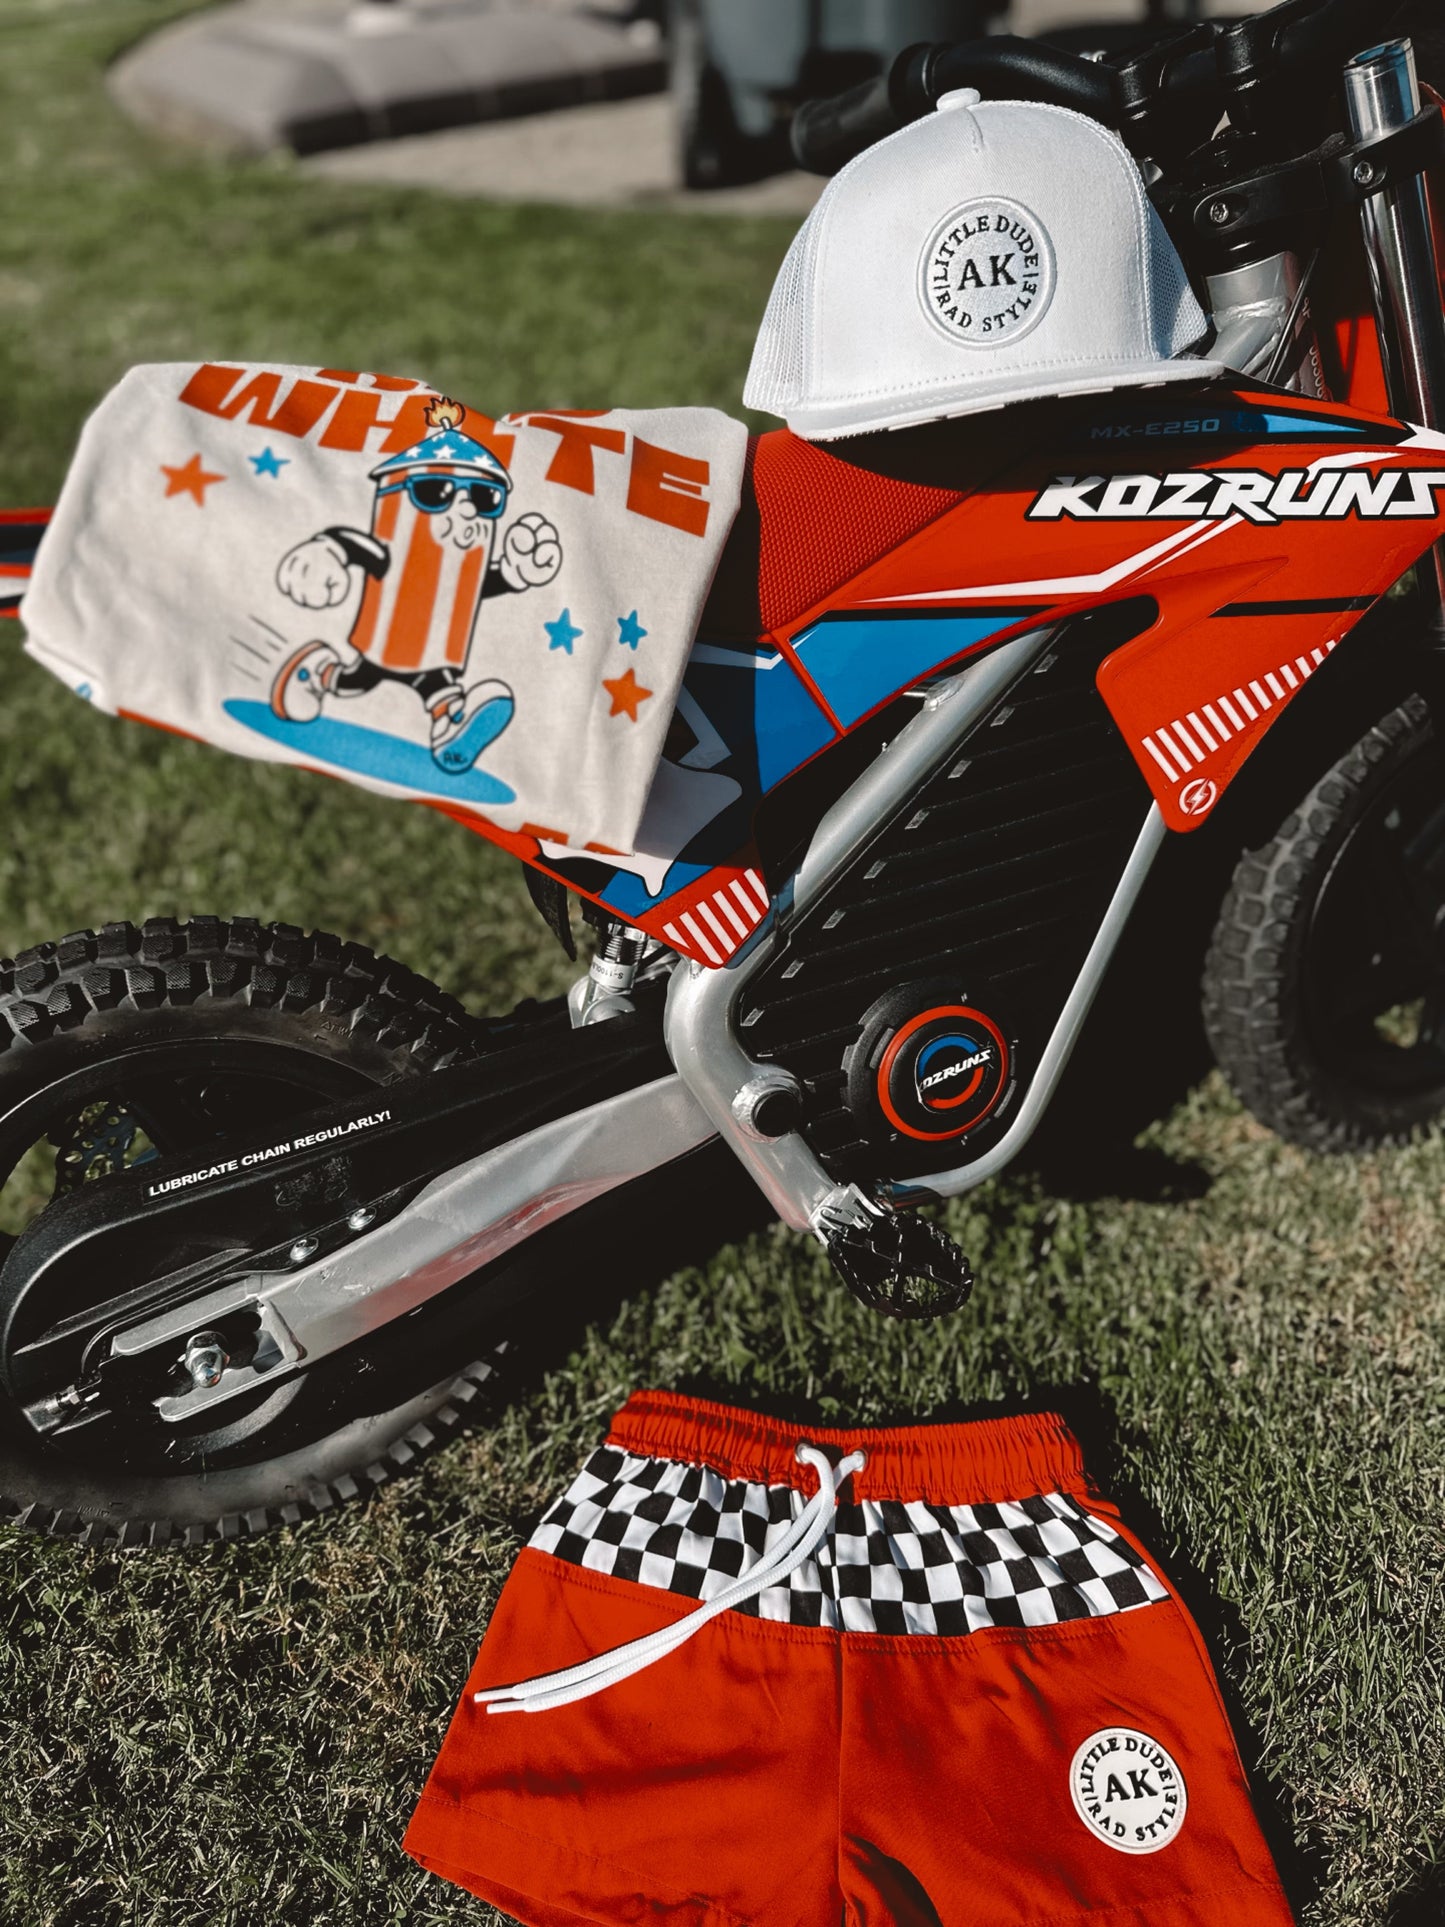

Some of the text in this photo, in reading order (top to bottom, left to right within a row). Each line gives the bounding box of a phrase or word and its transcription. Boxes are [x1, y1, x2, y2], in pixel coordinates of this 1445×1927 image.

[933, 214, 1039, 282] LITTLE DUDE
[957, 253, 1017, 291] AK
[936, 281, 1038, 332] RAD STYLE
[1090, 418, 1220, 439] MX-E250
[1028, 471, 1445, 522] KOZRUNS
[920, 1048, 991, 1092] OZRUNS
[149, 1110, 392, 1197] LUBRICATE CHAIN REGULARLY!
[1080, 1737, 1173, 1794] LITTLE DUDE
[1104, 1768, 1159, 1803] AK
[1087, 1792, 1178, 1842] RAD STYLE
